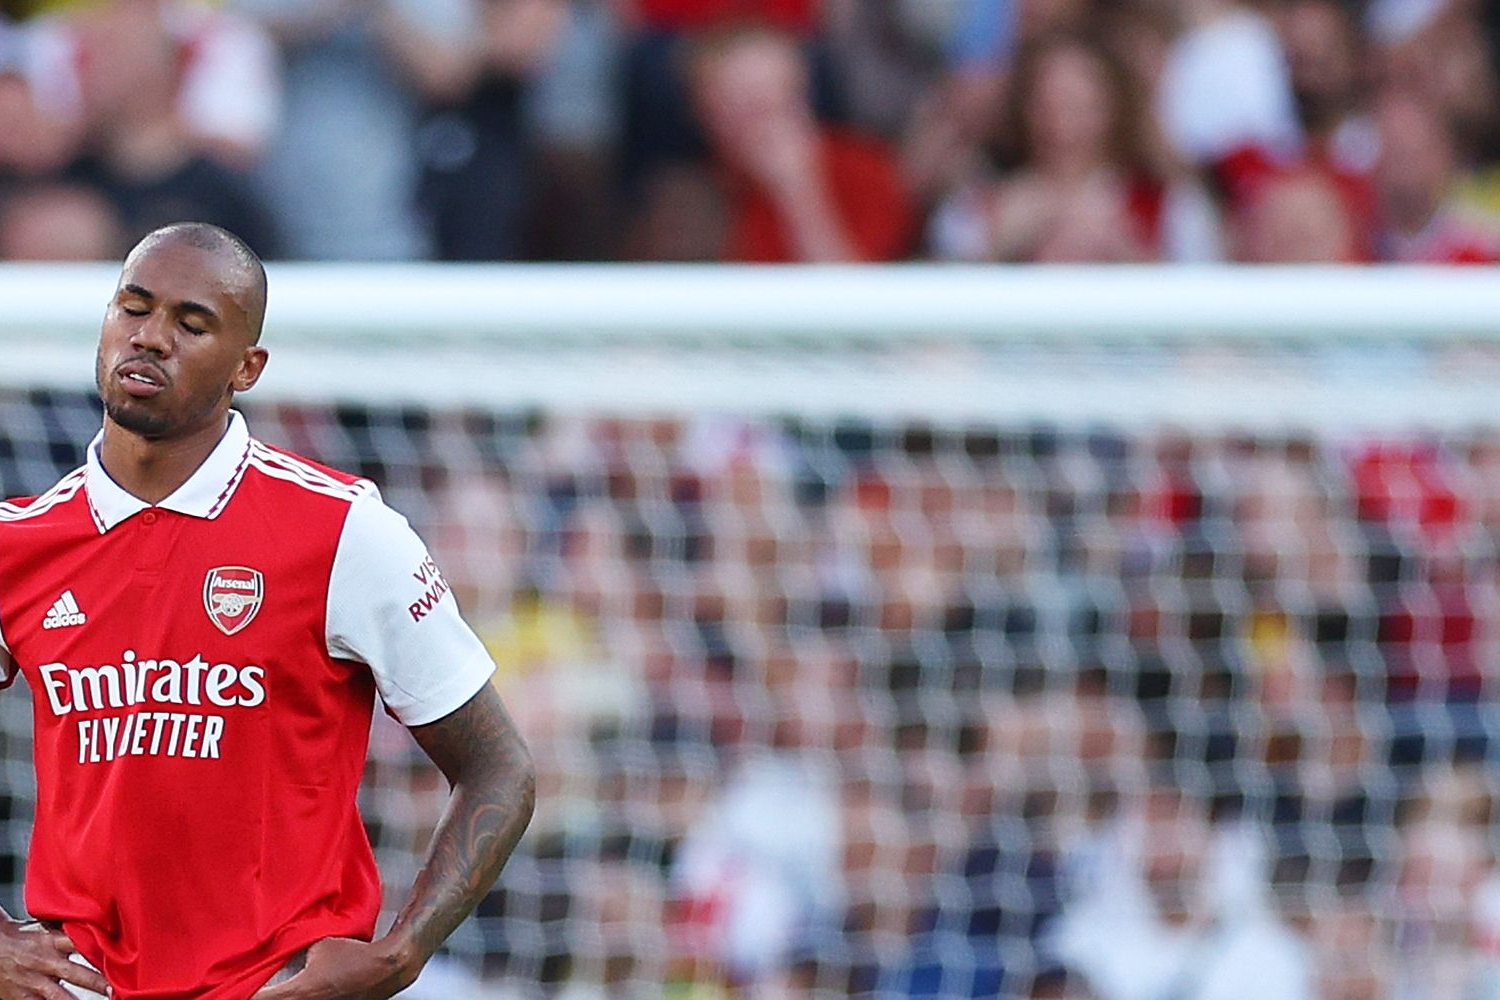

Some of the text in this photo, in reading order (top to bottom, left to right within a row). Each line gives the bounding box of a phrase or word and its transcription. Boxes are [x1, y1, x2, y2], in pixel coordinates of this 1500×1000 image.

[413, 555, 436, 585] VIS
[213, 576, 254, 590] Arsenal
[43, 612, 86, 629] adidas
[39, 650, 265, 716] Emirates
